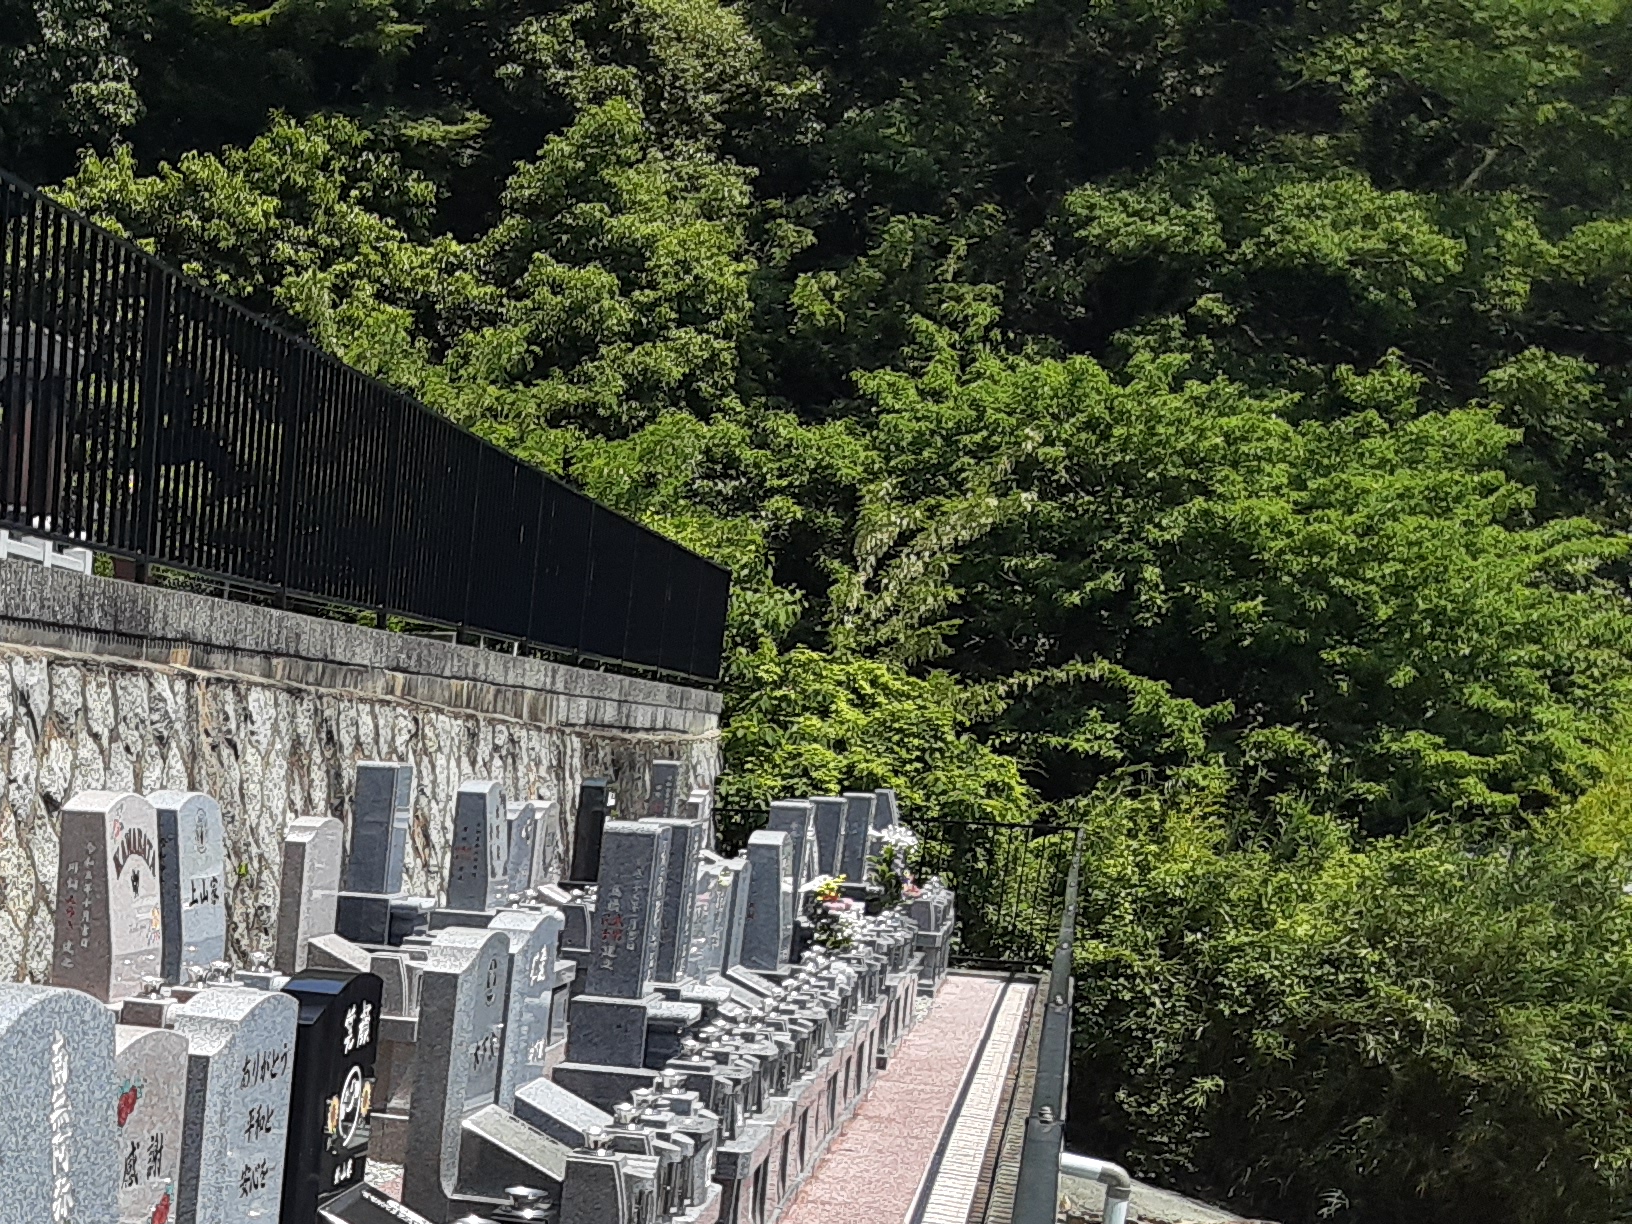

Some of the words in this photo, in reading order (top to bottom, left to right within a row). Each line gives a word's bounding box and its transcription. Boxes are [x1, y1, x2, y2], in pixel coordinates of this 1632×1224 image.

[239, 1042, 289, 1091] ありがとう
[243, 1103, 275, 1143] 平和と
[120, 1132, 164, 1189] 感謝
[238, 1157, 269, 1199] 安心を
